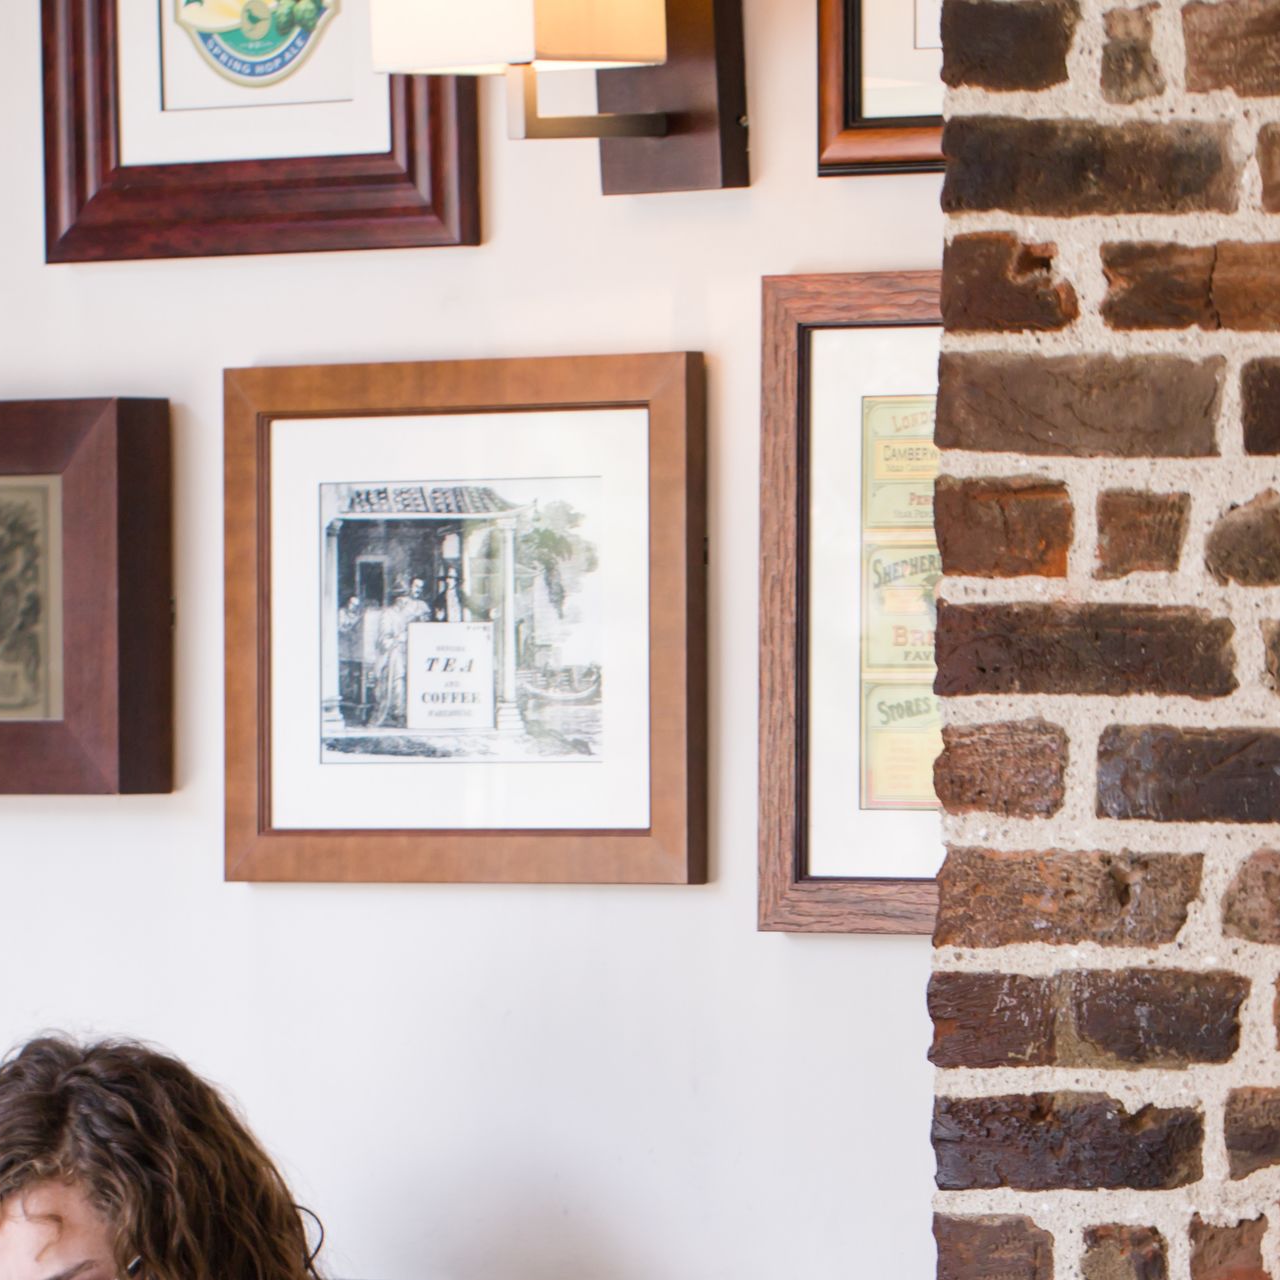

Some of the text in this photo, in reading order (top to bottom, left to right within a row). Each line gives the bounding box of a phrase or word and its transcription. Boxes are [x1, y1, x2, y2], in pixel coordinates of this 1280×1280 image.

[206, 37, 305, 75] SPRING HOP ALE
[425, 656, 475, 673] TEA
[421, 691, 481, 705] COFFEE
[877, 696, 932, 726] STORES
